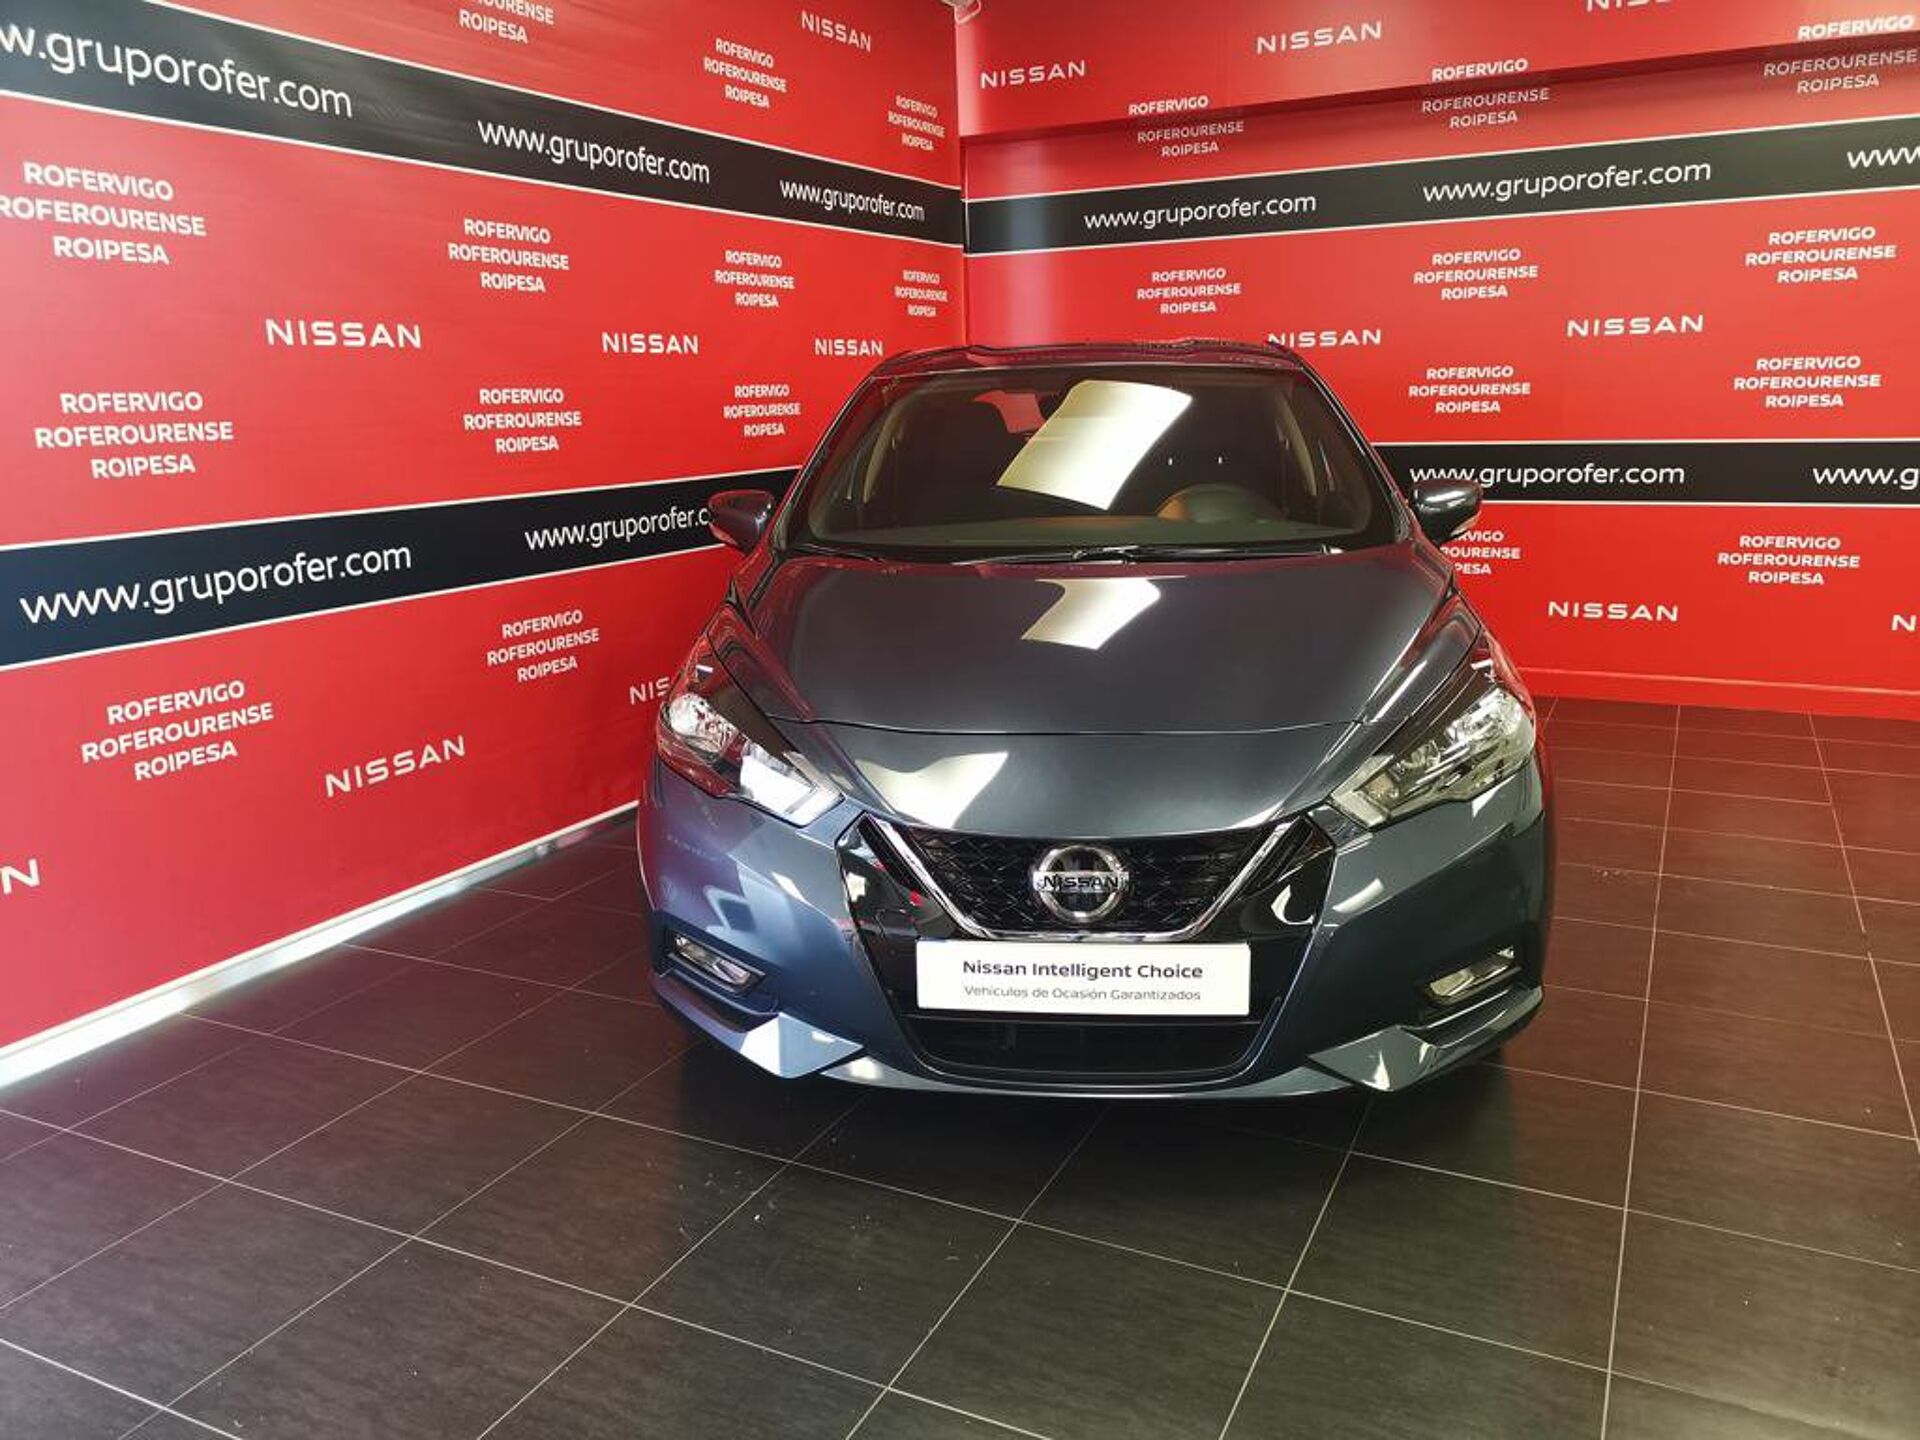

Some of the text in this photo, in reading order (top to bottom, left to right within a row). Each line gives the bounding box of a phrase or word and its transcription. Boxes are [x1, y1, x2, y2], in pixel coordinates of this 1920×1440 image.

[460, 8, 529, 43] ROIPESA
[802, 11, 870, 52] NISSAN
[1797, 13, 1916, 41] ROFERVIGO
[1258, 21, 1382, 53] NISSAN
[714, 38, 773, 69] ROFERVIGO
[1764, 49, 1917, 78] ROFEROURENSE
[704, 56, 786, 93] ROFEROURENSE
[980, 60, 1085, 89] NISSAN
[1431, 58, 1528, 82] ROFERVIGO
[1797, 74, 1879, 94] ROIPESA
[725, 84, 771, 108] ROIPESA
[1129, 95, 1209, 115] ROFERVIGO
[1422, 88, 1549, 113] ROFEROURENSE
[1450, 110, 1517, 128] ROIPESA
[1138, 121, 1243, 143] ROFEROURENSE
[476, 119, 711, 184] www.gruporofer.com
[1162, 142, 1219, 157] ROIPESA
[22, 162, 173, 201] ROFERVIGO
[1423, 163, 1713, 202] www.gruporofer.com
[778, 178, 926, 222] www.gruporofer.com
[0, 195, 206, 237] ROFEROURENSE
[1084, 196, 1318, 231] www.gruporofer.com
[463, 218, 550, 245] ROFERVIGO
[1769, 227, 1878, 247] ROFERVIGO
[53, 236, 169, 264] ROIPESA
[448, 243, 569, 270] ROFEROURENSE
[725, 250, 782, 268] ROFERVIGO
[1432, 249, 1521, 265] ROFERVIGO
[1746, 245, 1896, 265] ROFEROURENSE
[480, 272, 545, 292] ROIPESA
[715, 270, 794, 289] ROFEROURENSE
[1152, 268, 1226, 282] ROFERVIGO
[1414, 266, 1538, 283] ROFEROURENSE
[1777, 267, 1858, 283] ROIPESA
[735, 292, 778, 307] ROIPESA
[1137, 283, 1240, 299] ROFEROURENSE
[1441, 285, 1508, 300] ROIPESA
[1161, 301, 1216, 313] ROIPESA
[266, 319, 420, 348] NISSAN
[1568, 315, 1703, 336] NISSAN
[602, 333, 698, 354] NISSAN
[815, 339, 883, 356] NISSAN
[1269, 329, 1381, 347] NISSAN
[1427, 366, 1513, 379] ROFERVIGO
[1757, 356, 1860, 370] ROFERVIGO
[735, 384, 789, 398] ROFERVIGO
[1409, 383, 1530, 396] ROFEROURENSE
[1734, 374, 1881, 389] ROFEROURENSE
[60, 392, 202, 413] ROFERVIGO
[480, 388, 563, 404] ROFERVIGO
[1766, 394, 1843, 407] ROIPESA
[724, 403, 800, 418] ROFEROURENSE
[1436, 401, 1500, 413] ROIPESA
[464, 411, 581, 430] ROFEROURENSE
[744, 423, 785, 436] ROIPESA
[34, 422, 233, 448] ROFEROURENSE
[496, 436, 559, 452] ROIPESA
[91, 454, 195, 478] ROIPESA
[1410, 463, 1684, 488] www.gruporofer.com
[1740, 536, 1840, 549] ROFERVIGO
[1718, 553, 1860, 568] ROFEROURENSE
[20, 546, 411, 623] www.gruporofer.com
[1749, 571, 1824, 584] ROIPESA
[1549, 601, 1678, 621] NISSAN
[502, 610, 584, 640] ROFERVIGO
[487, 626, 599, 668] ROFEROURENSE
[517, 656, 577, 682] ROIPESA
[107, 681, 246, 726] ROFERVIGO
[81, 701, 273, 765] ROFEROURENSE
[133, 739, 237, 780] ROIPESA
[326, 736, 465, 797] NISSAN
[1042, 876, 1118, 889] NISSAN
[963, 960, 1204, 981] Nissan Intelligent Choice
[1032, 986, 1049, 999] de
[1052, 986, 1108, 1000] Ocasión
[1110, 989, 1201, 1001] Garantizados
